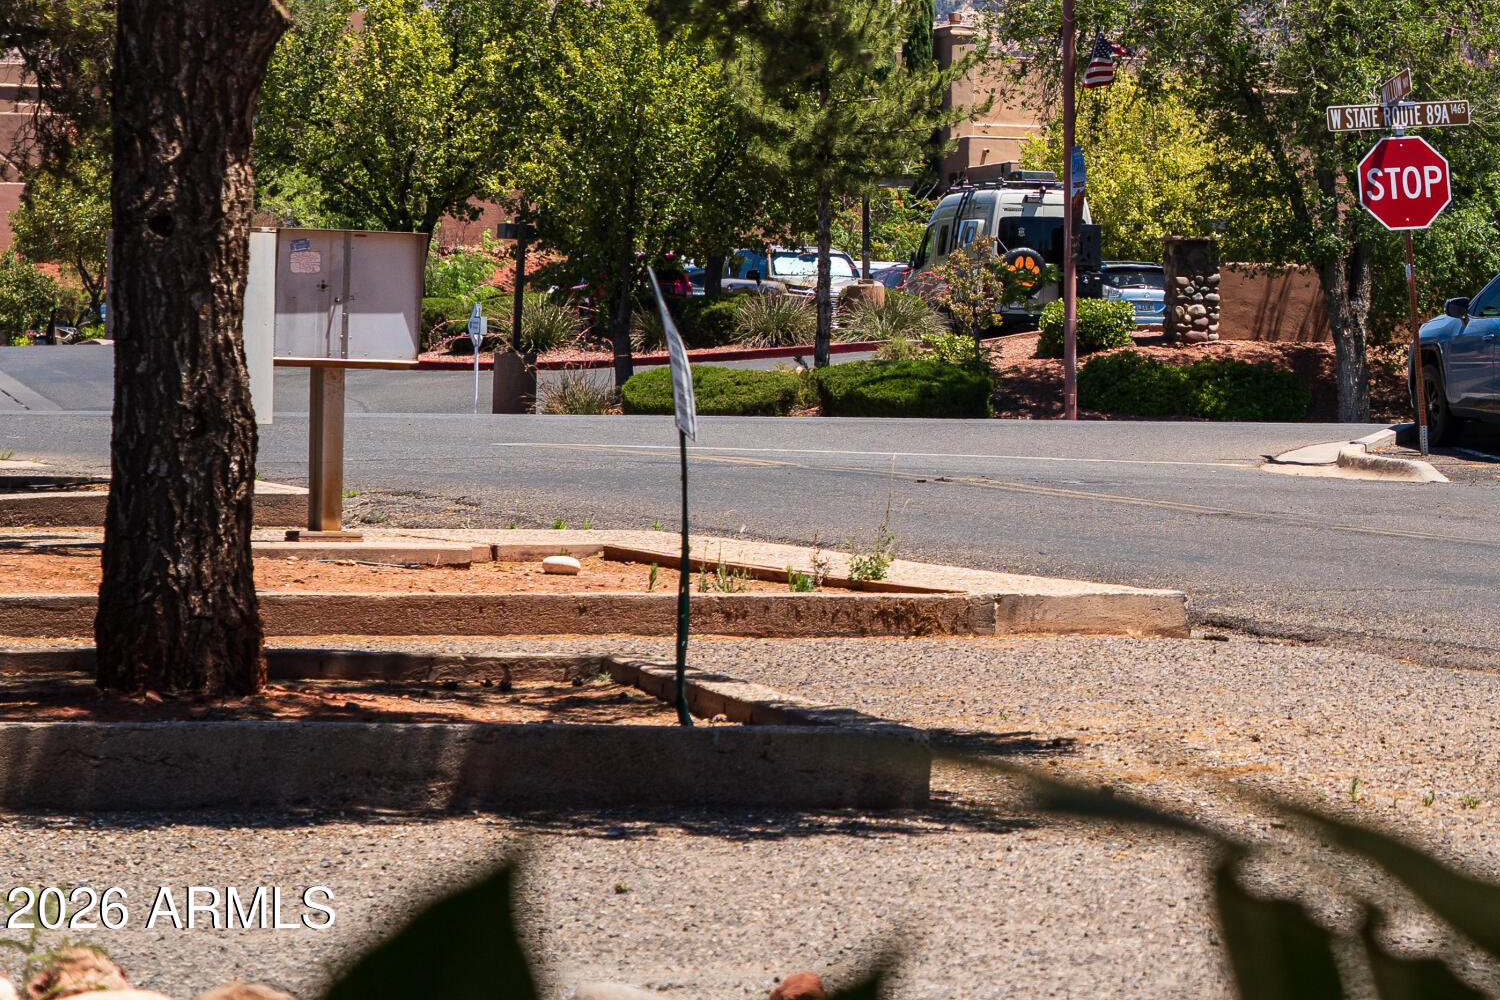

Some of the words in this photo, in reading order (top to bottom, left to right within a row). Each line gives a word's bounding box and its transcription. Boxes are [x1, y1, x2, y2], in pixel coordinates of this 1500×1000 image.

[1330, 109, 1341, 129] W
[1345, 107, 1379, 129] STATE
[1383, 105, 1422, 127] ROUTE
[1426, 104, 1450, 125] 89A
[1450, 103, 1465, 114] 1465
[1366, 165, 1442, 201] STOP
